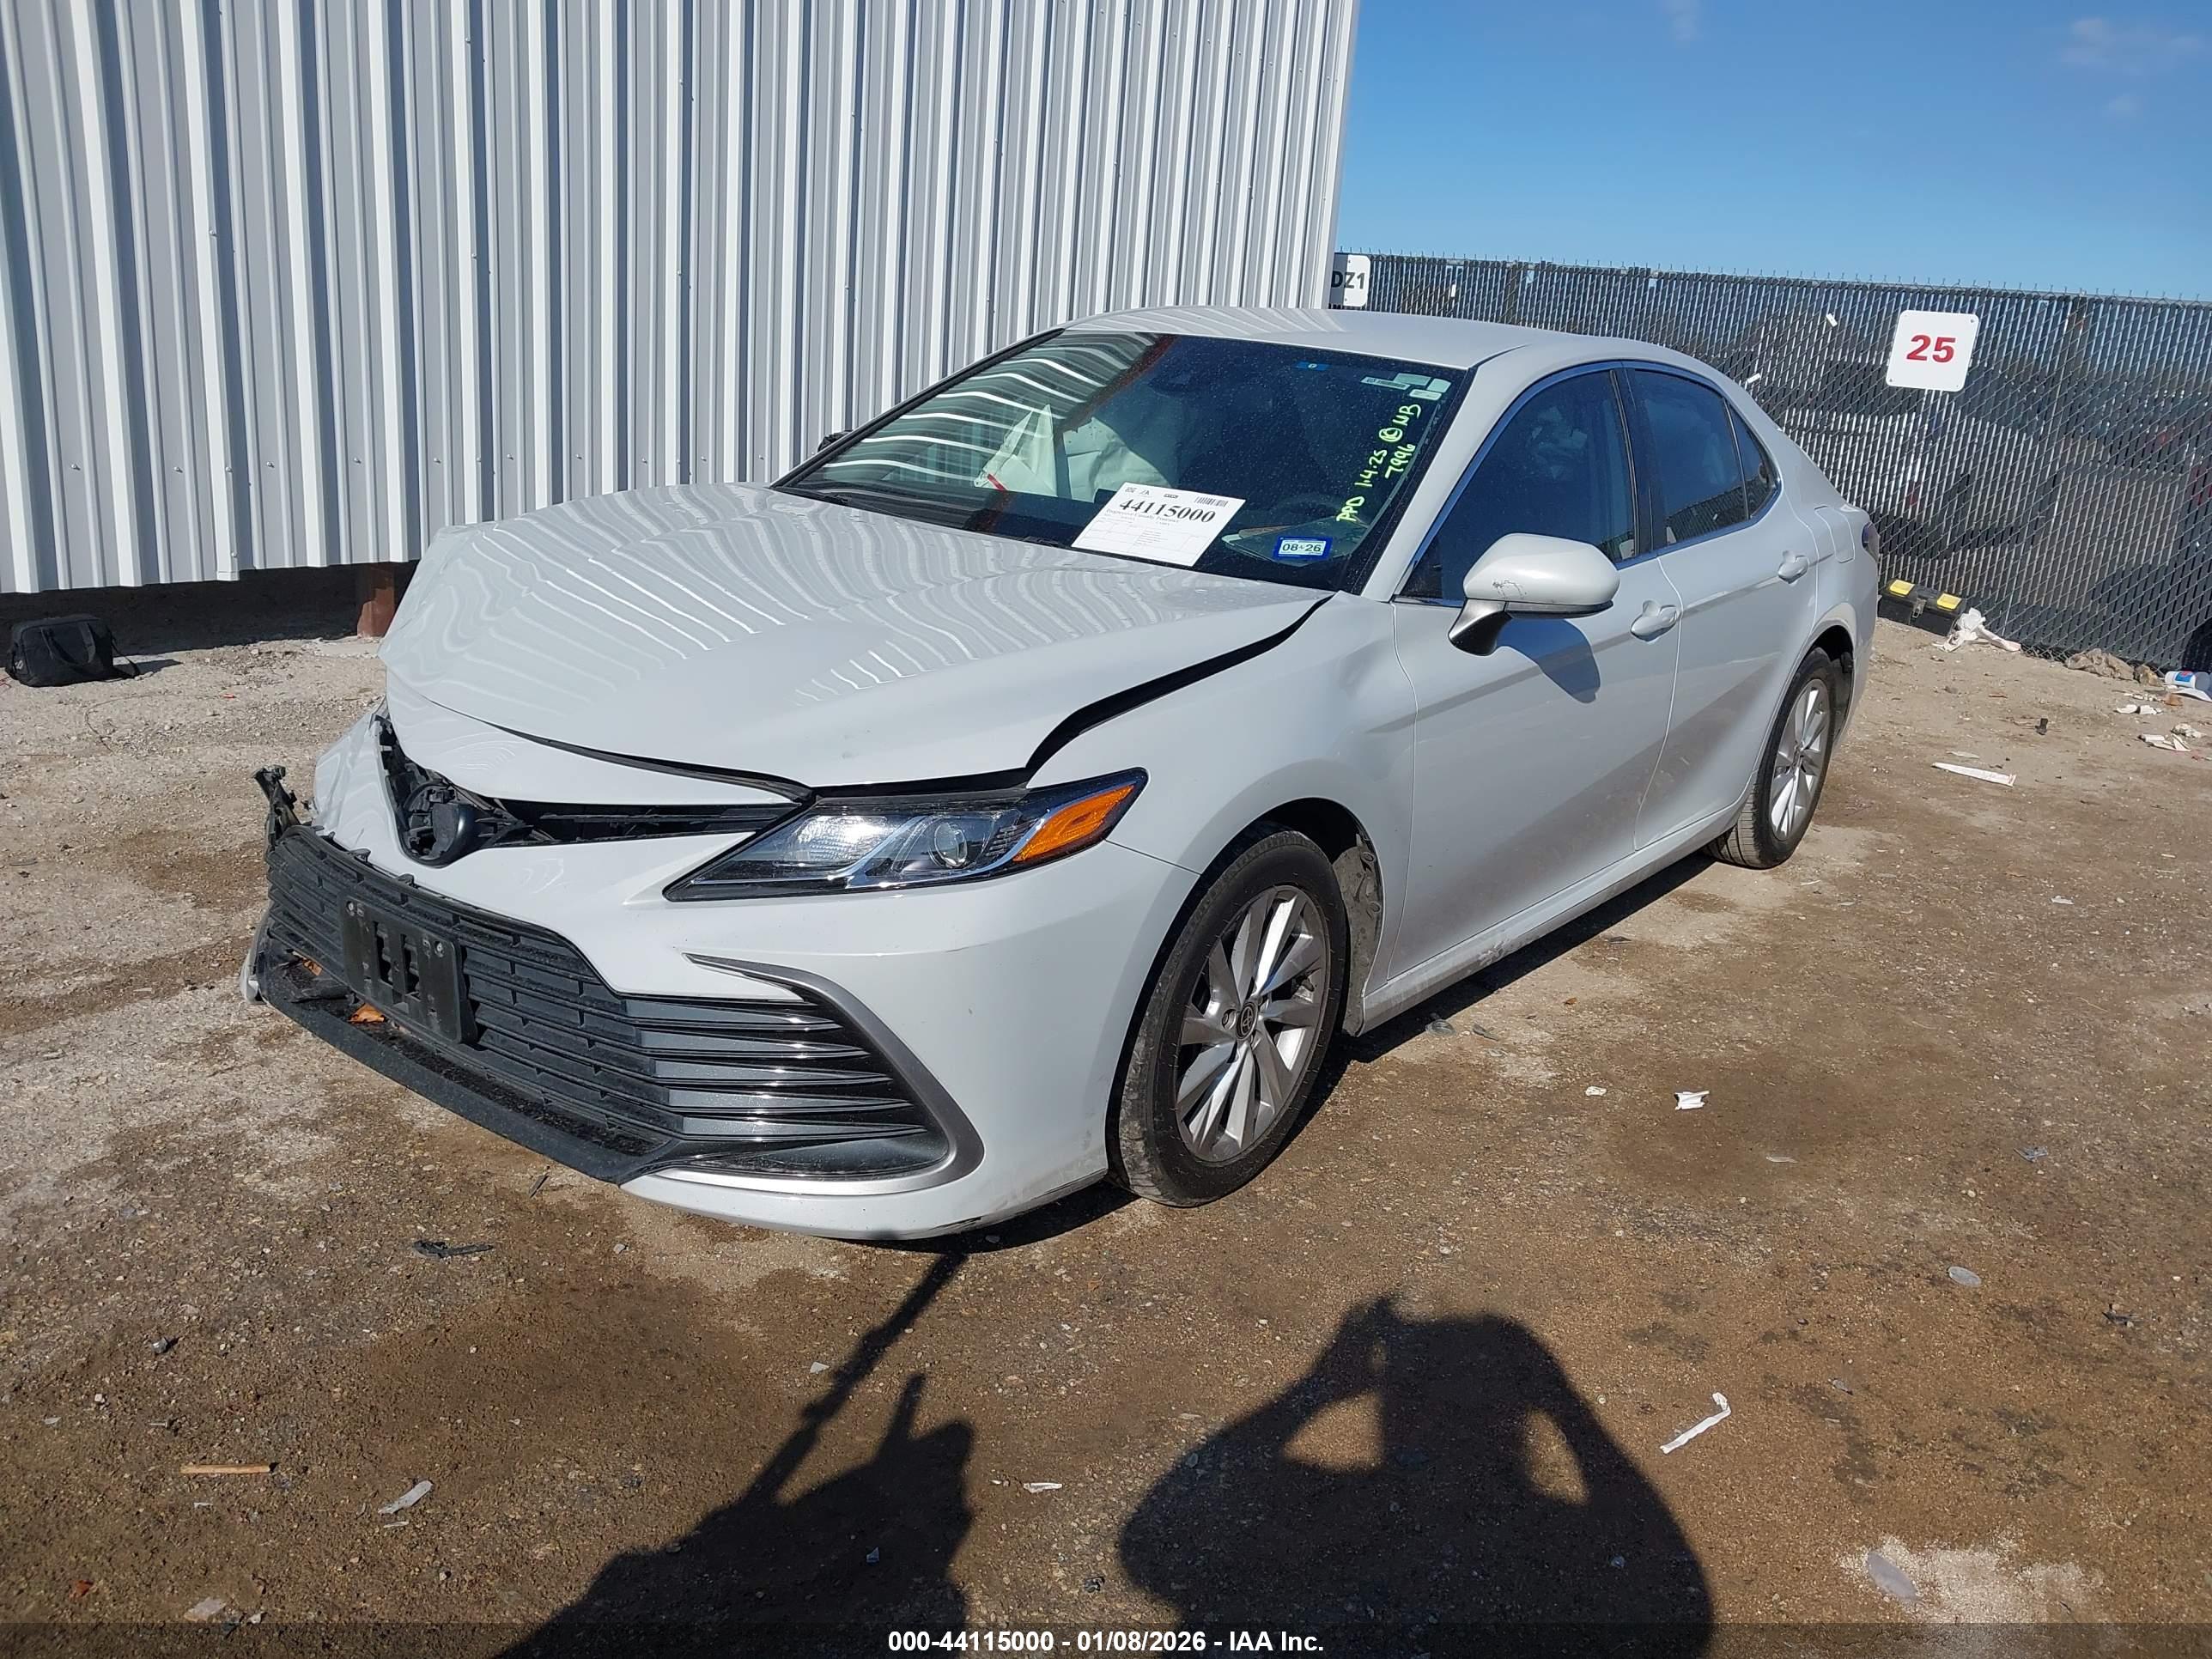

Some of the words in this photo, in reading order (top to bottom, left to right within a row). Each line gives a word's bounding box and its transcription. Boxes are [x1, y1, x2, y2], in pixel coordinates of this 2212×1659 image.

[1331, 270, 1365, 289] DZ1
[1905, 334, 1957, 363] 25
[1119, 498, 1217, 523] 44115000
